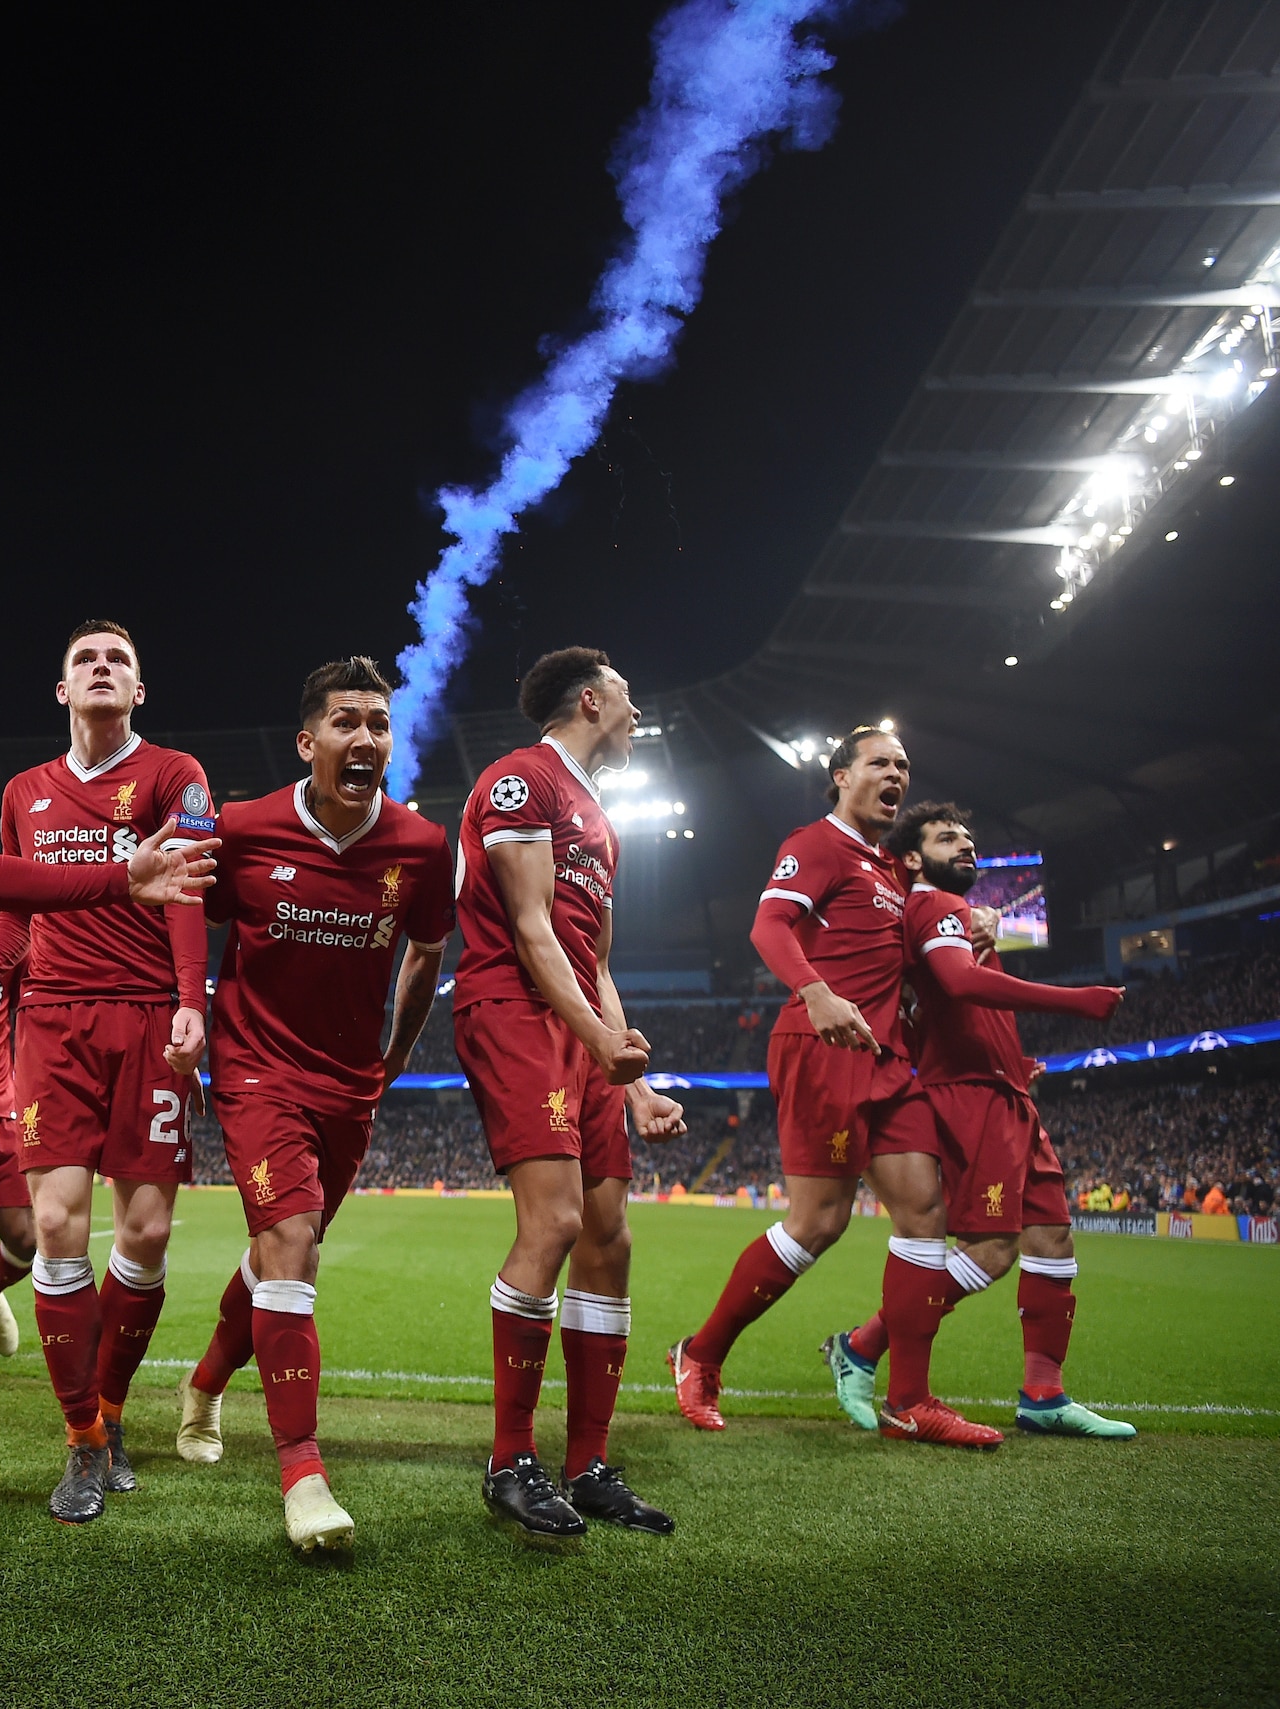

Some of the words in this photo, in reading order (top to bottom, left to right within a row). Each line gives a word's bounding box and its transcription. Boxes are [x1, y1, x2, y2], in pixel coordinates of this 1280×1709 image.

[192, 798, 199, 807] 5
[180, 816, 215, 829] RESPECT
[33, 826, 107, 847] Standard
[276, 901, 373, 929] Standard
[268, 922, 369, 949] Chartered
[1123, 1217, 1156, 1235] LEAGUE
